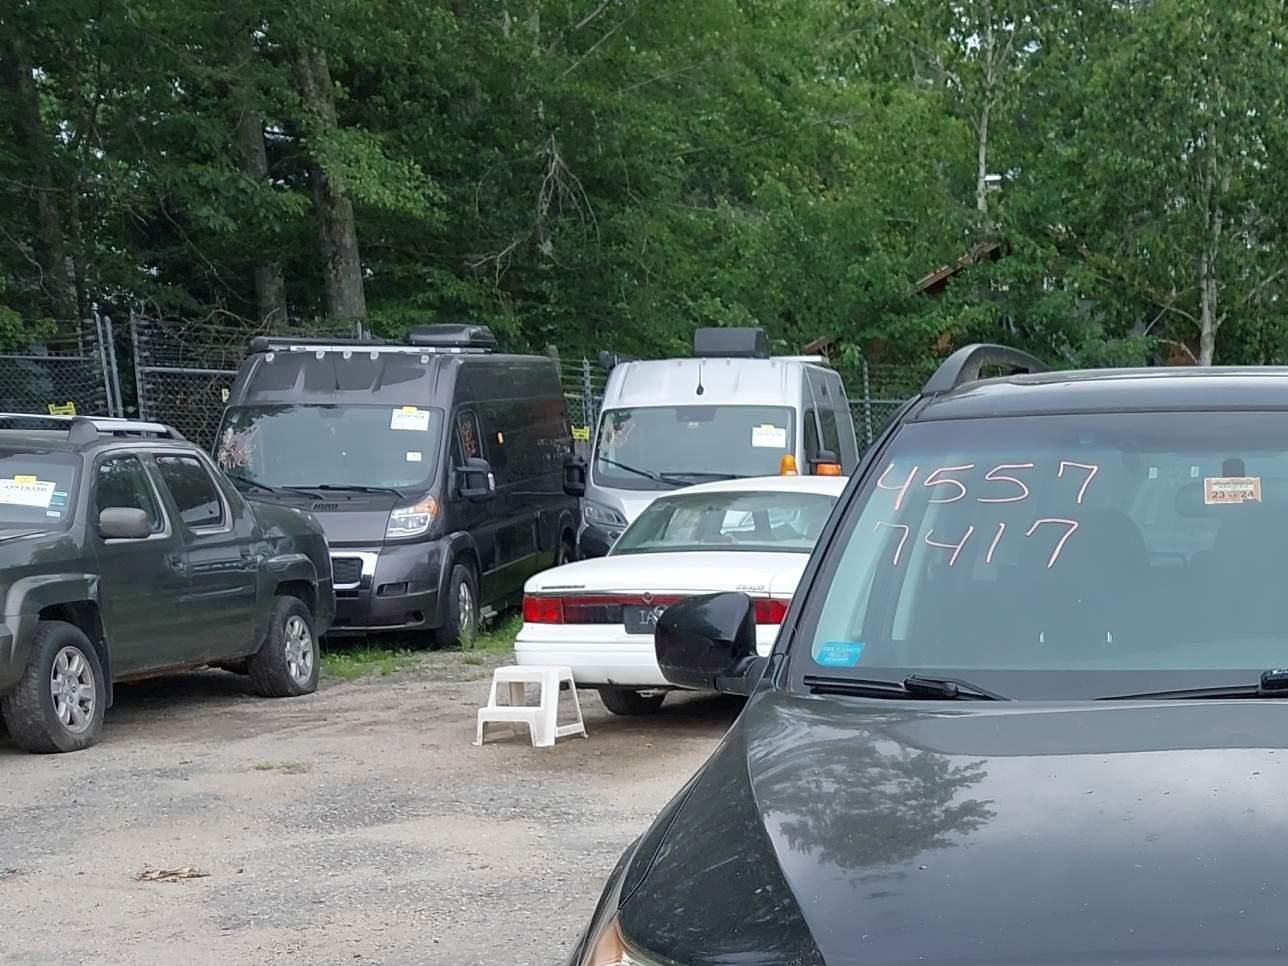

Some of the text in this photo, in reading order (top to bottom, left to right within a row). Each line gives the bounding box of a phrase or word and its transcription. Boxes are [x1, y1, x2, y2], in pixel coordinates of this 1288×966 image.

[876, 462, 1099, 511] 4557
[1211, 490, 1225, 499] 23
[873, 517, 1080, 569] 7417
